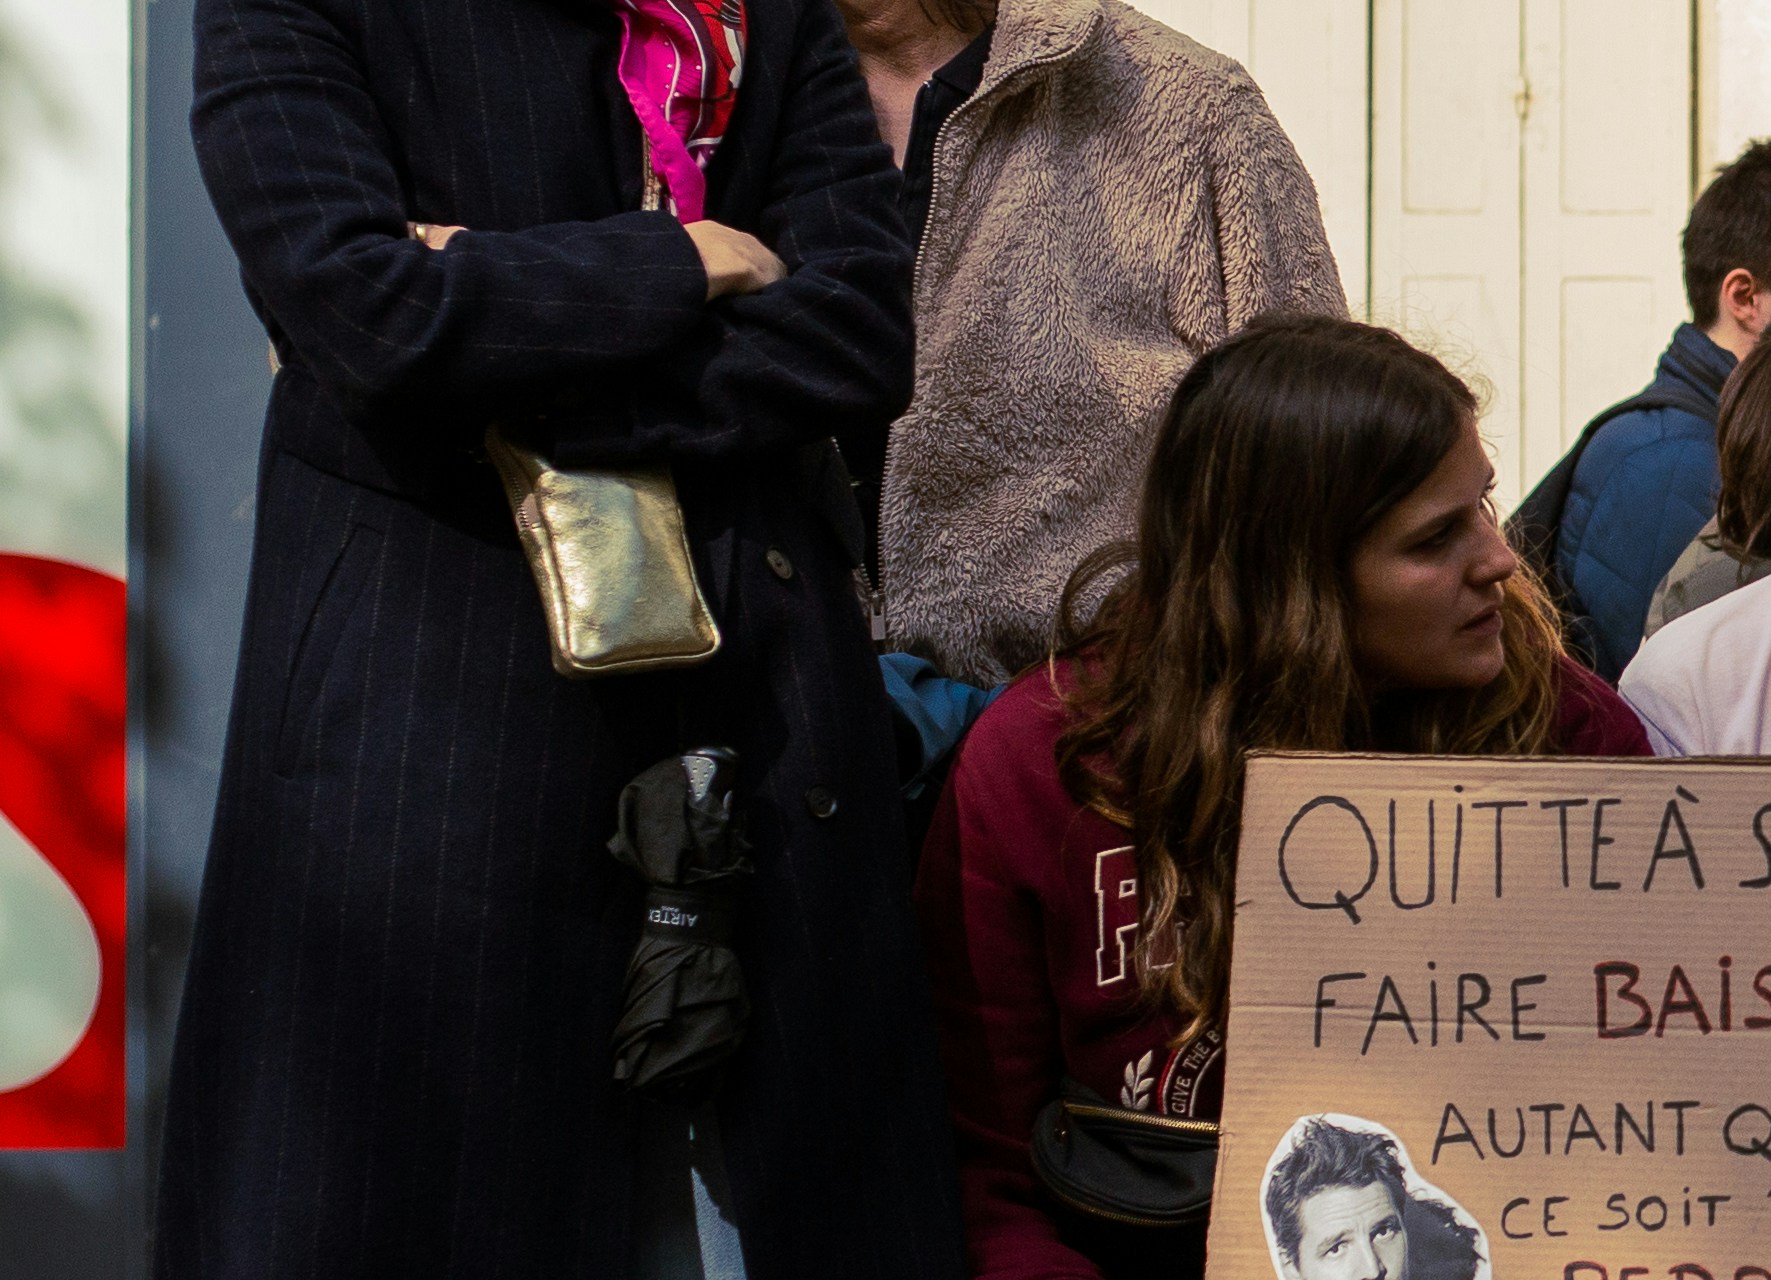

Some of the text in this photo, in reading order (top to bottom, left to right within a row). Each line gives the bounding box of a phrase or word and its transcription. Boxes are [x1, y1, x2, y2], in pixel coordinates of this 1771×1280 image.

[1171, 1076, 1192, 1114] GIVE
[1182, 1041, 1210, 1070] THE
[1431, 1101, 1700, 1165] AUTANT
[1500, 1195, 1570, 1239] CE
